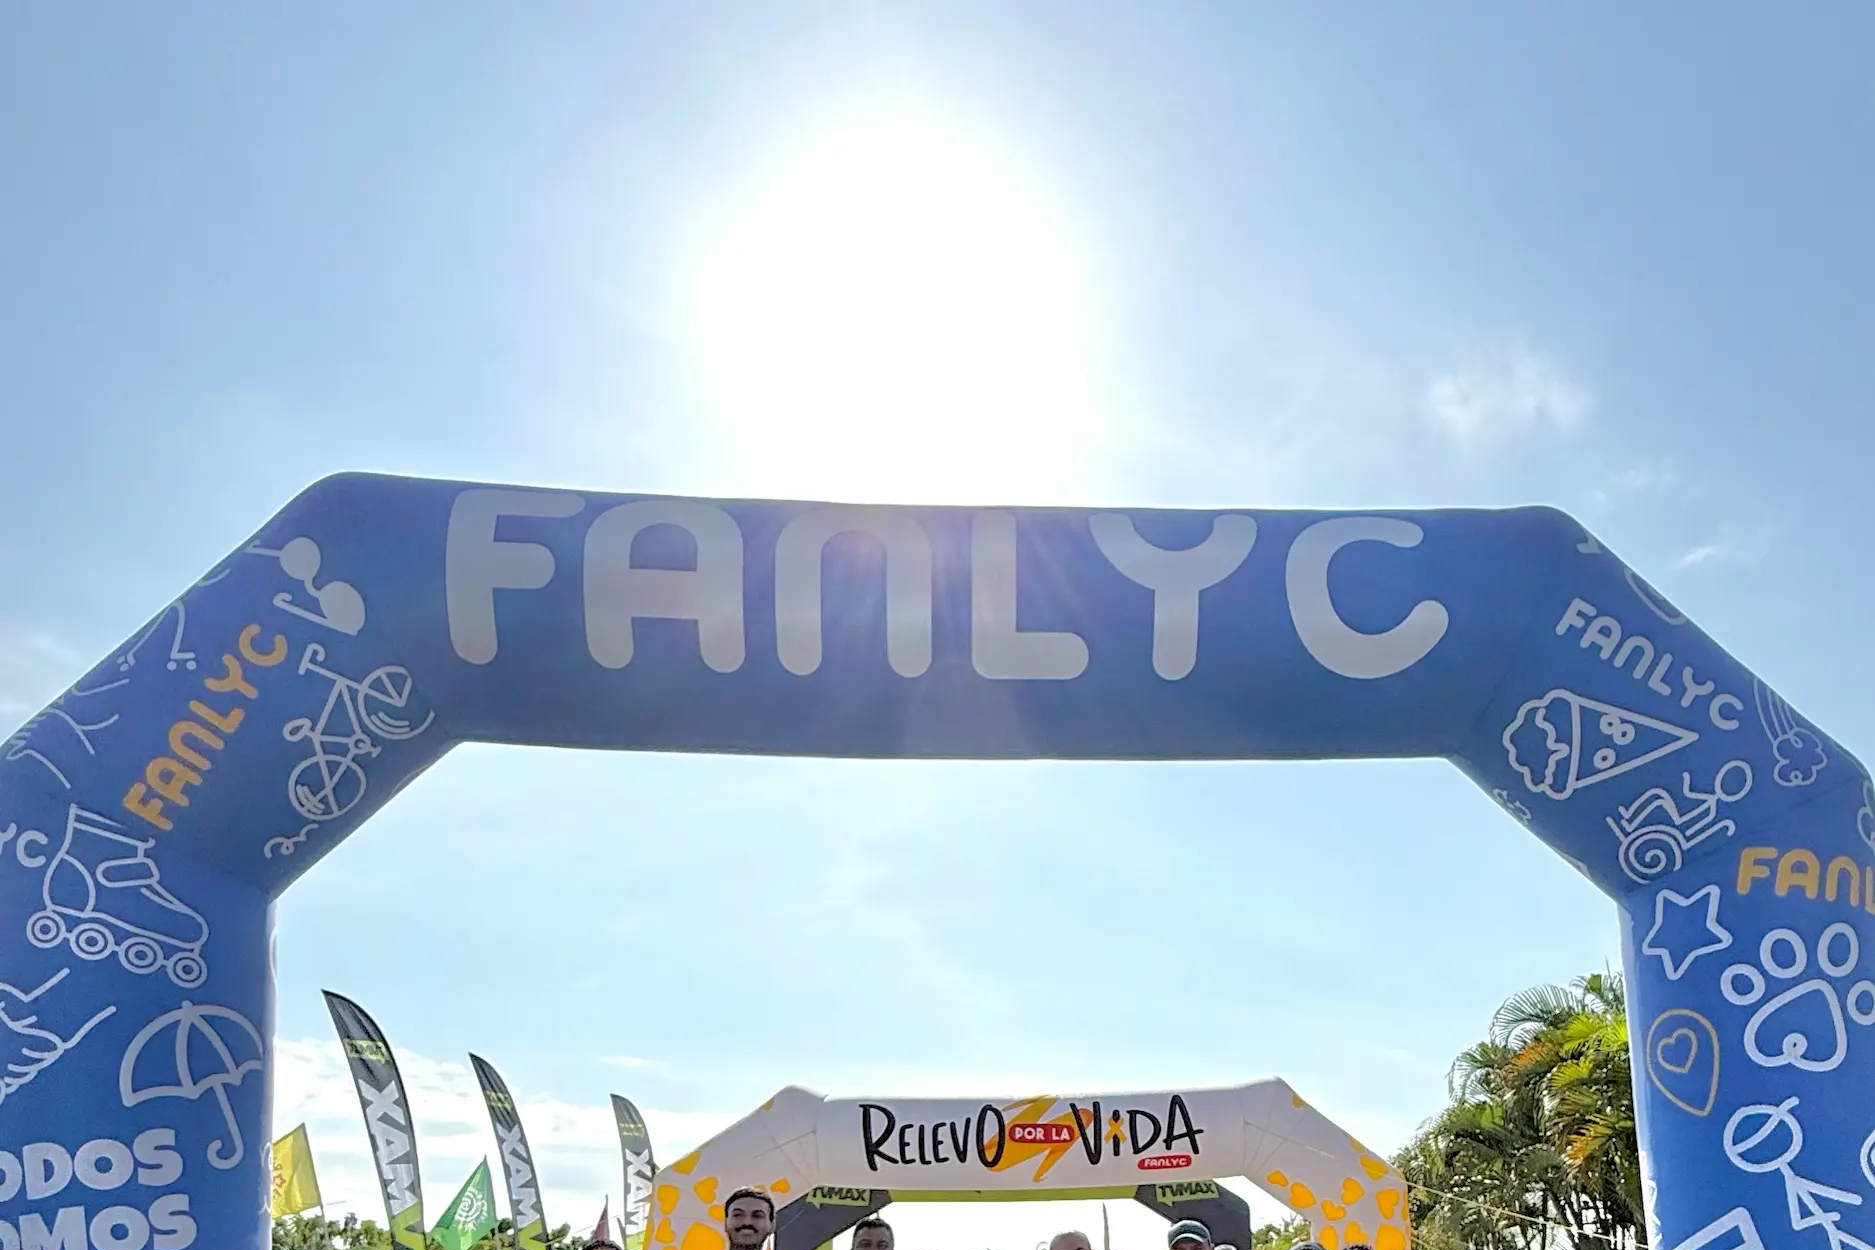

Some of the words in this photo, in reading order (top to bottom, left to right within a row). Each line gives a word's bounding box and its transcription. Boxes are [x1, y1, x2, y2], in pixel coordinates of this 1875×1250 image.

[446, 488, 1449, 680] FANLYC
[1556, 597, 1744, 729] FANLYC
[122, 624, 288, 830] FANLYC
[859, 1104, 1005, 1171] RELEVO
[1013, 1126, 1044, 1141] POR
[1051, 1126, 1071, 1141] LA
[1144, 1157, 1188, 1167] FANLYC
[1158, 1182, 1215, 1198] TVMAX
